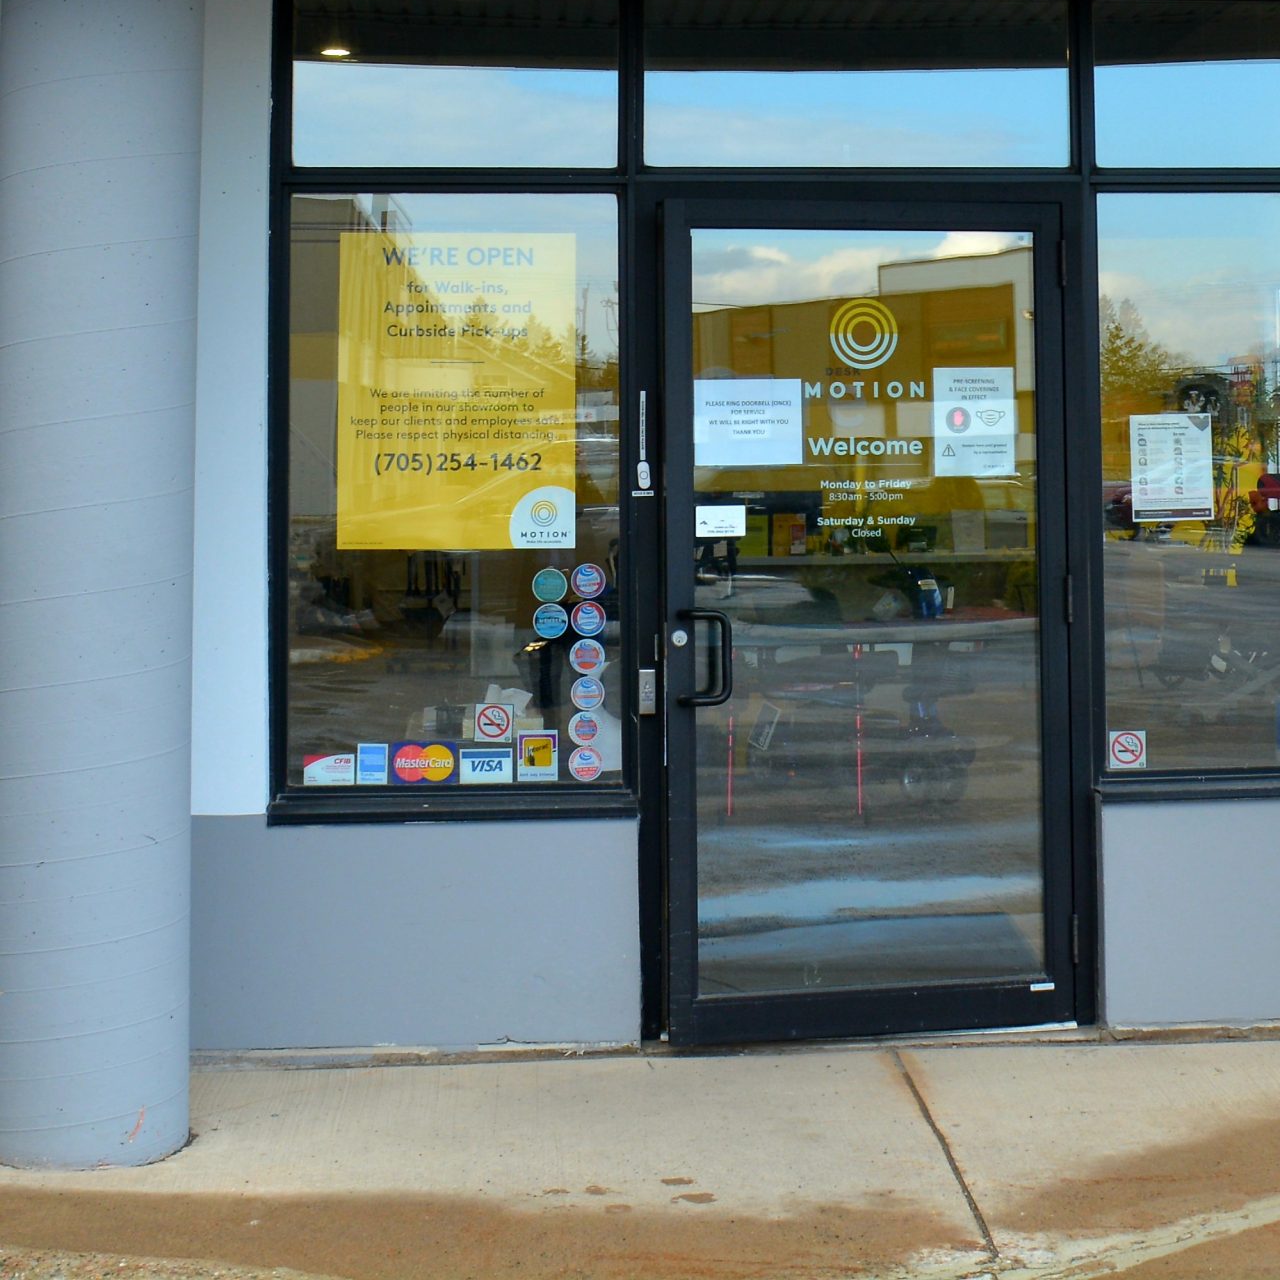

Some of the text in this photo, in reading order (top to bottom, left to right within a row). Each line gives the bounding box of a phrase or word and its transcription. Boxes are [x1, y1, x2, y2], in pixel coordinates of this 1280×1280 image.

[382, 247, 534, 266] WE'RE OPEN
[406, 280, 508, 295] for Walk-ins,
[384, 300, 532, 317] Appointments and
[386, 323, 528, 340] Curbside Pick-ups
[370, 388, 545, 401] We are limiting the number of
[804, 381, 925, 399] MOTION
[380, 402, 535, 414] people in our showroom to
[350, 415, 565, 428] keep our clients and employees safe.
[356, 429, 558, 443] Please respect physical distancing.
[807, 436, 923, 456] Welcome
[820, 479, 912, 490] Monday to Friday
[816, 515, 916, 527] Saturday & Sunday
[851, 528, 882, 538] Closed
[395, 757, 454, 769] MasterCard
[470, 759, 504, 772] VISA
